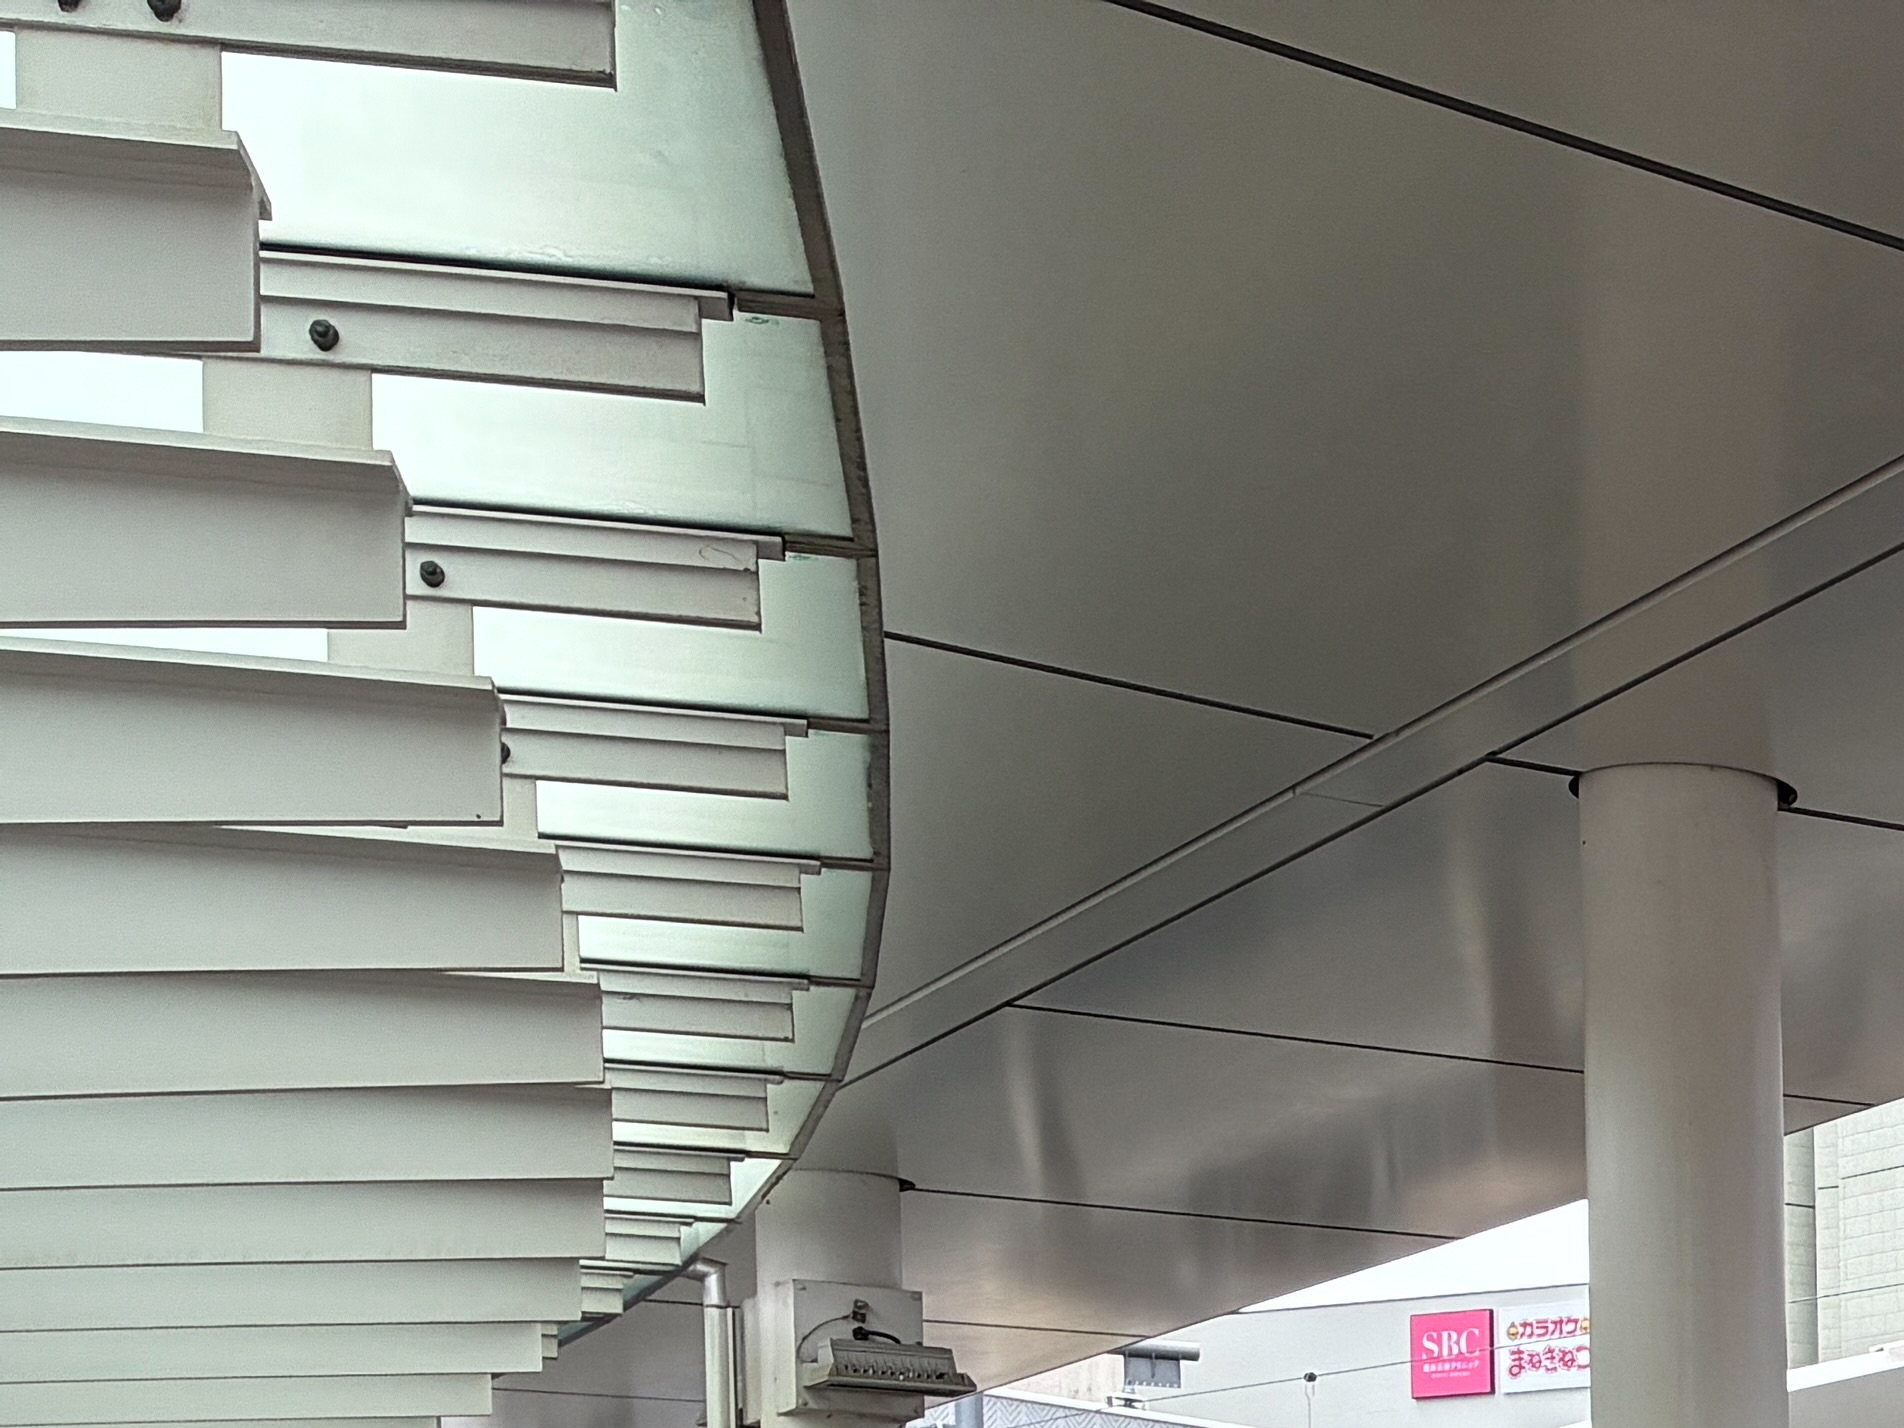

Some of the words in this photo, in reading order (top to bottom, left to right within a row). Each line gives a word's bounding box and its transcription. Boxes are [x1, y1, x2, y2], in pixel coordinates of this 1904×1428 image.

[1519, 1317, 1580, 1339] カラオケ
[1422, 1328, 1480, 1360] SBC
